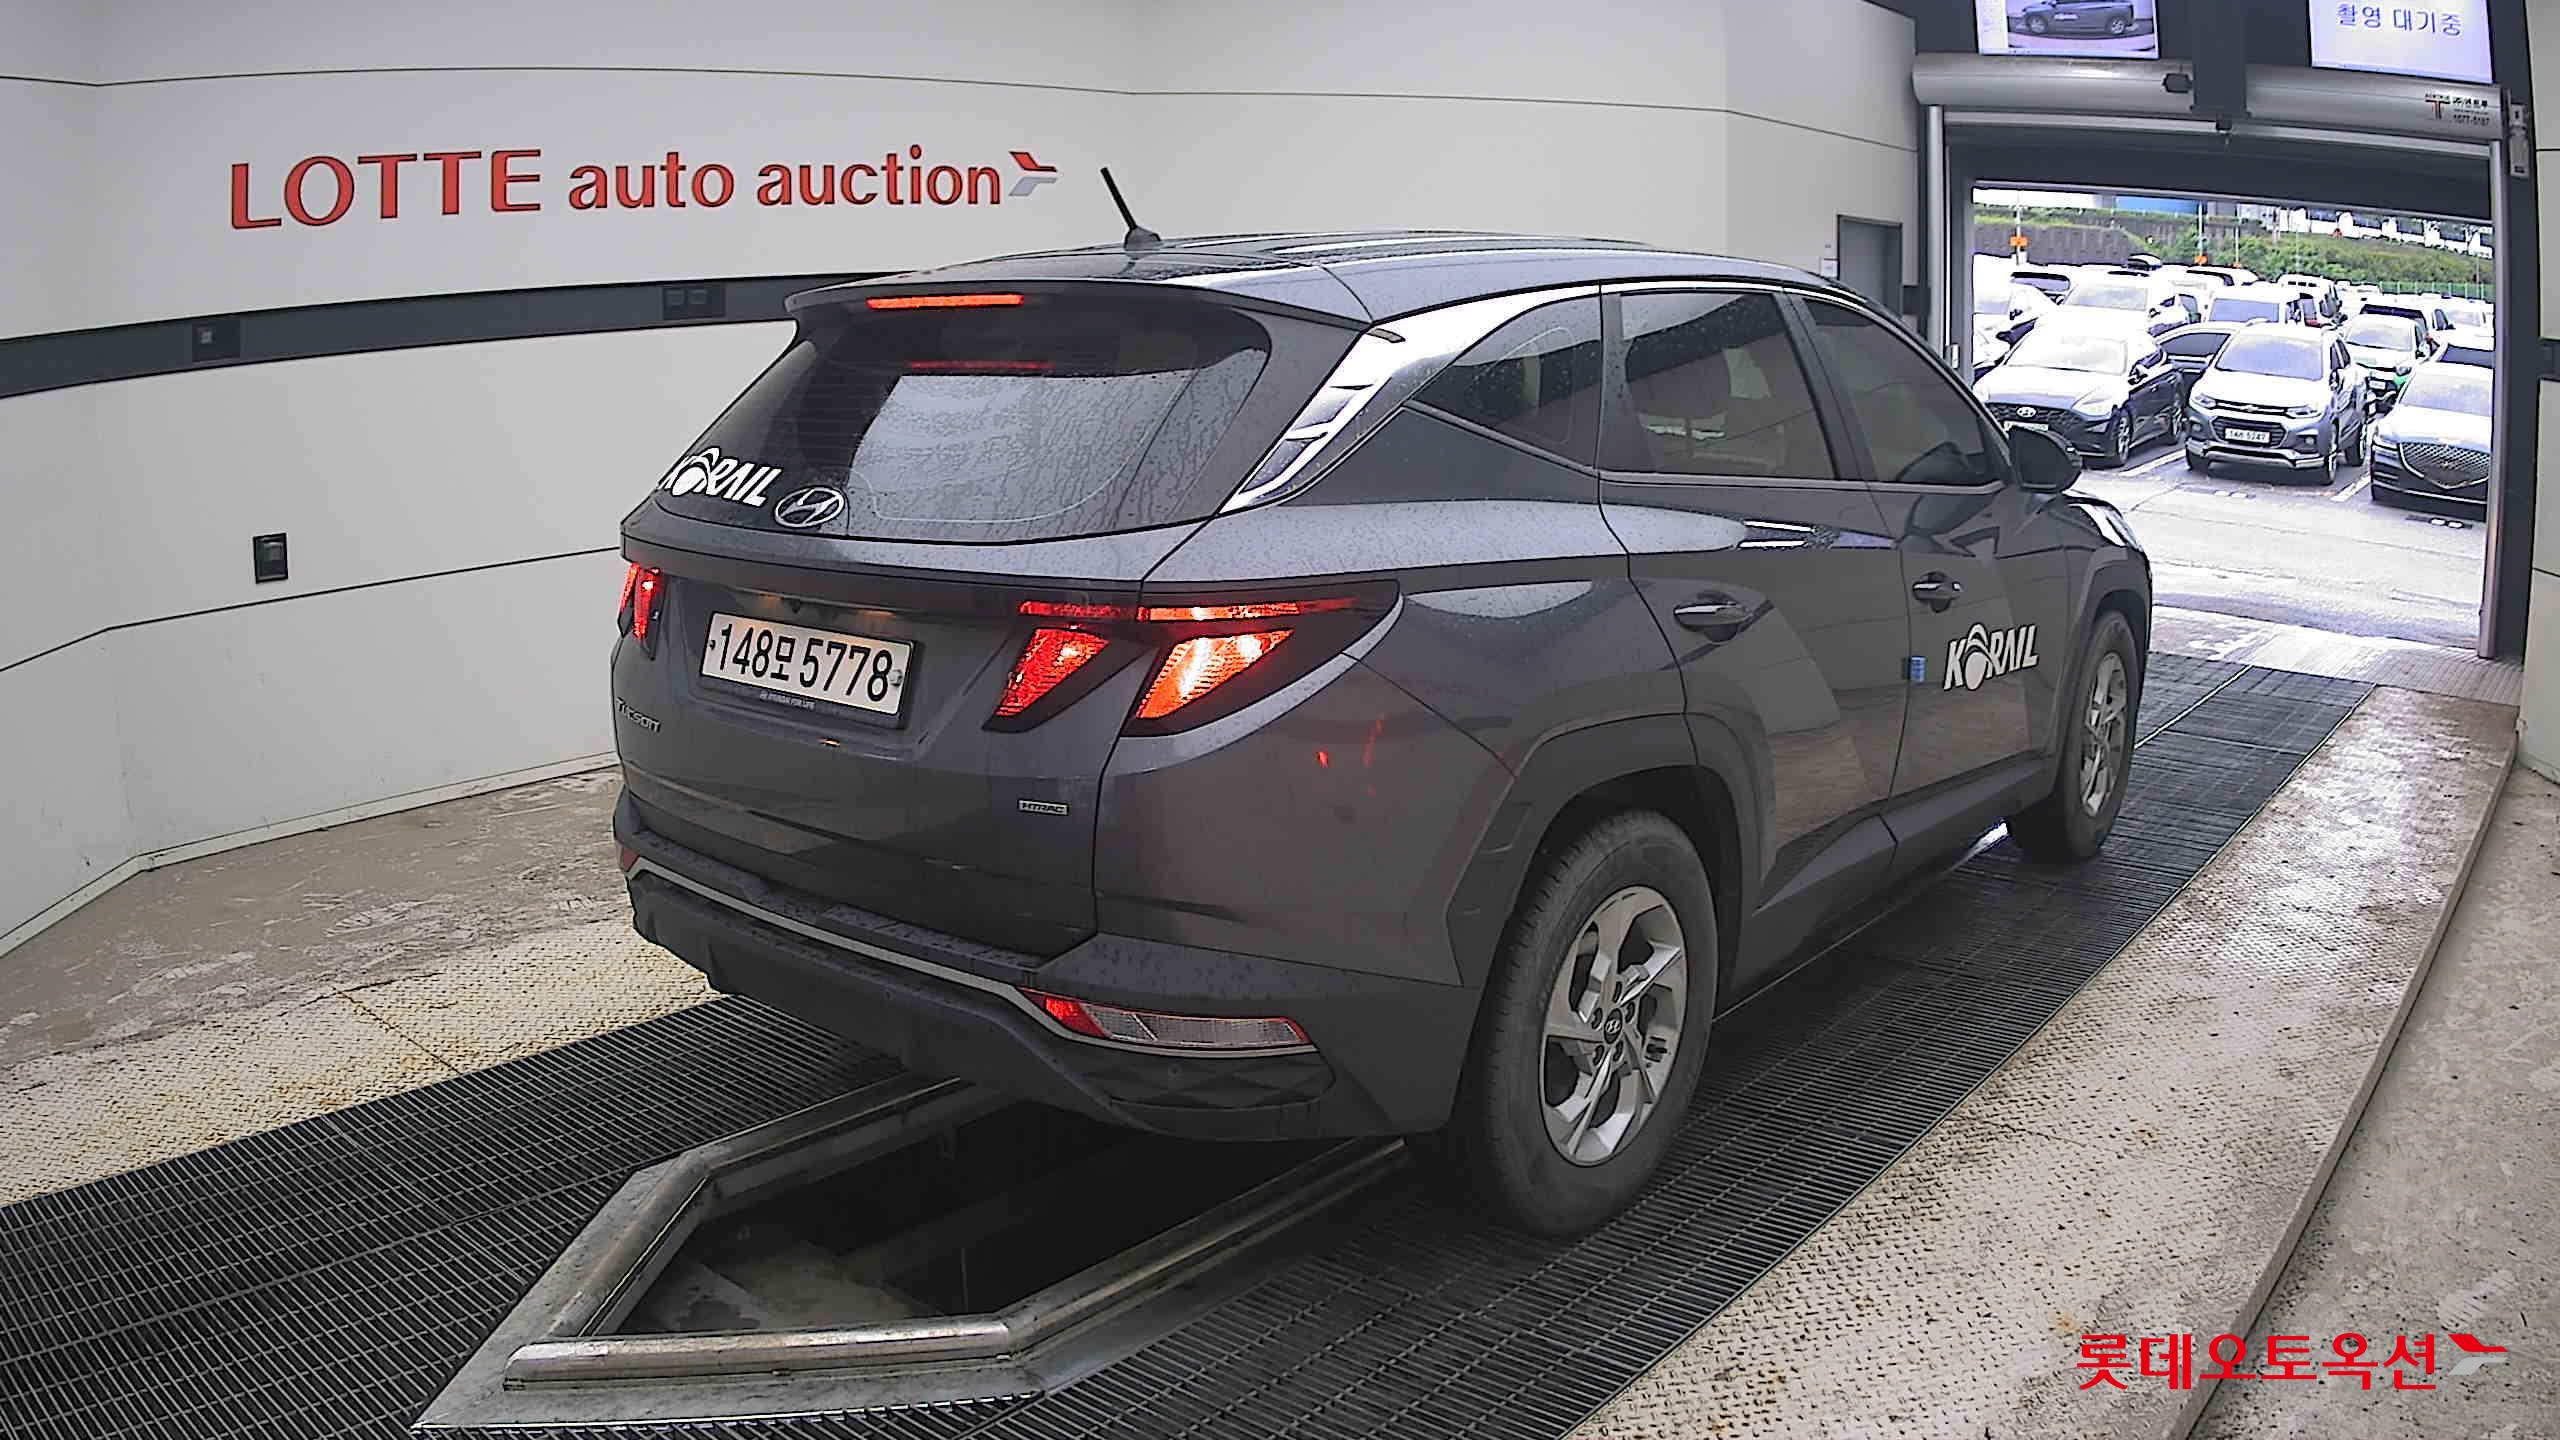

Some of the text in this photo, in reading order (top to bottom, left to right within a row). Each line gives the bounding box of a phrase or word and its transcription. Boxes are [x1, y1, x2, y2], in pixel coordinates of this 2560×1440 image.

[2393, 9, 2462, 36] 대기중
[231, 144, 1001, 229] LOTTE auto auction
[658, 447, 782, 507] KORAIL
[800, 637, 893, 702] 5778
[1943, 623, 2038, 690] KORAIL
